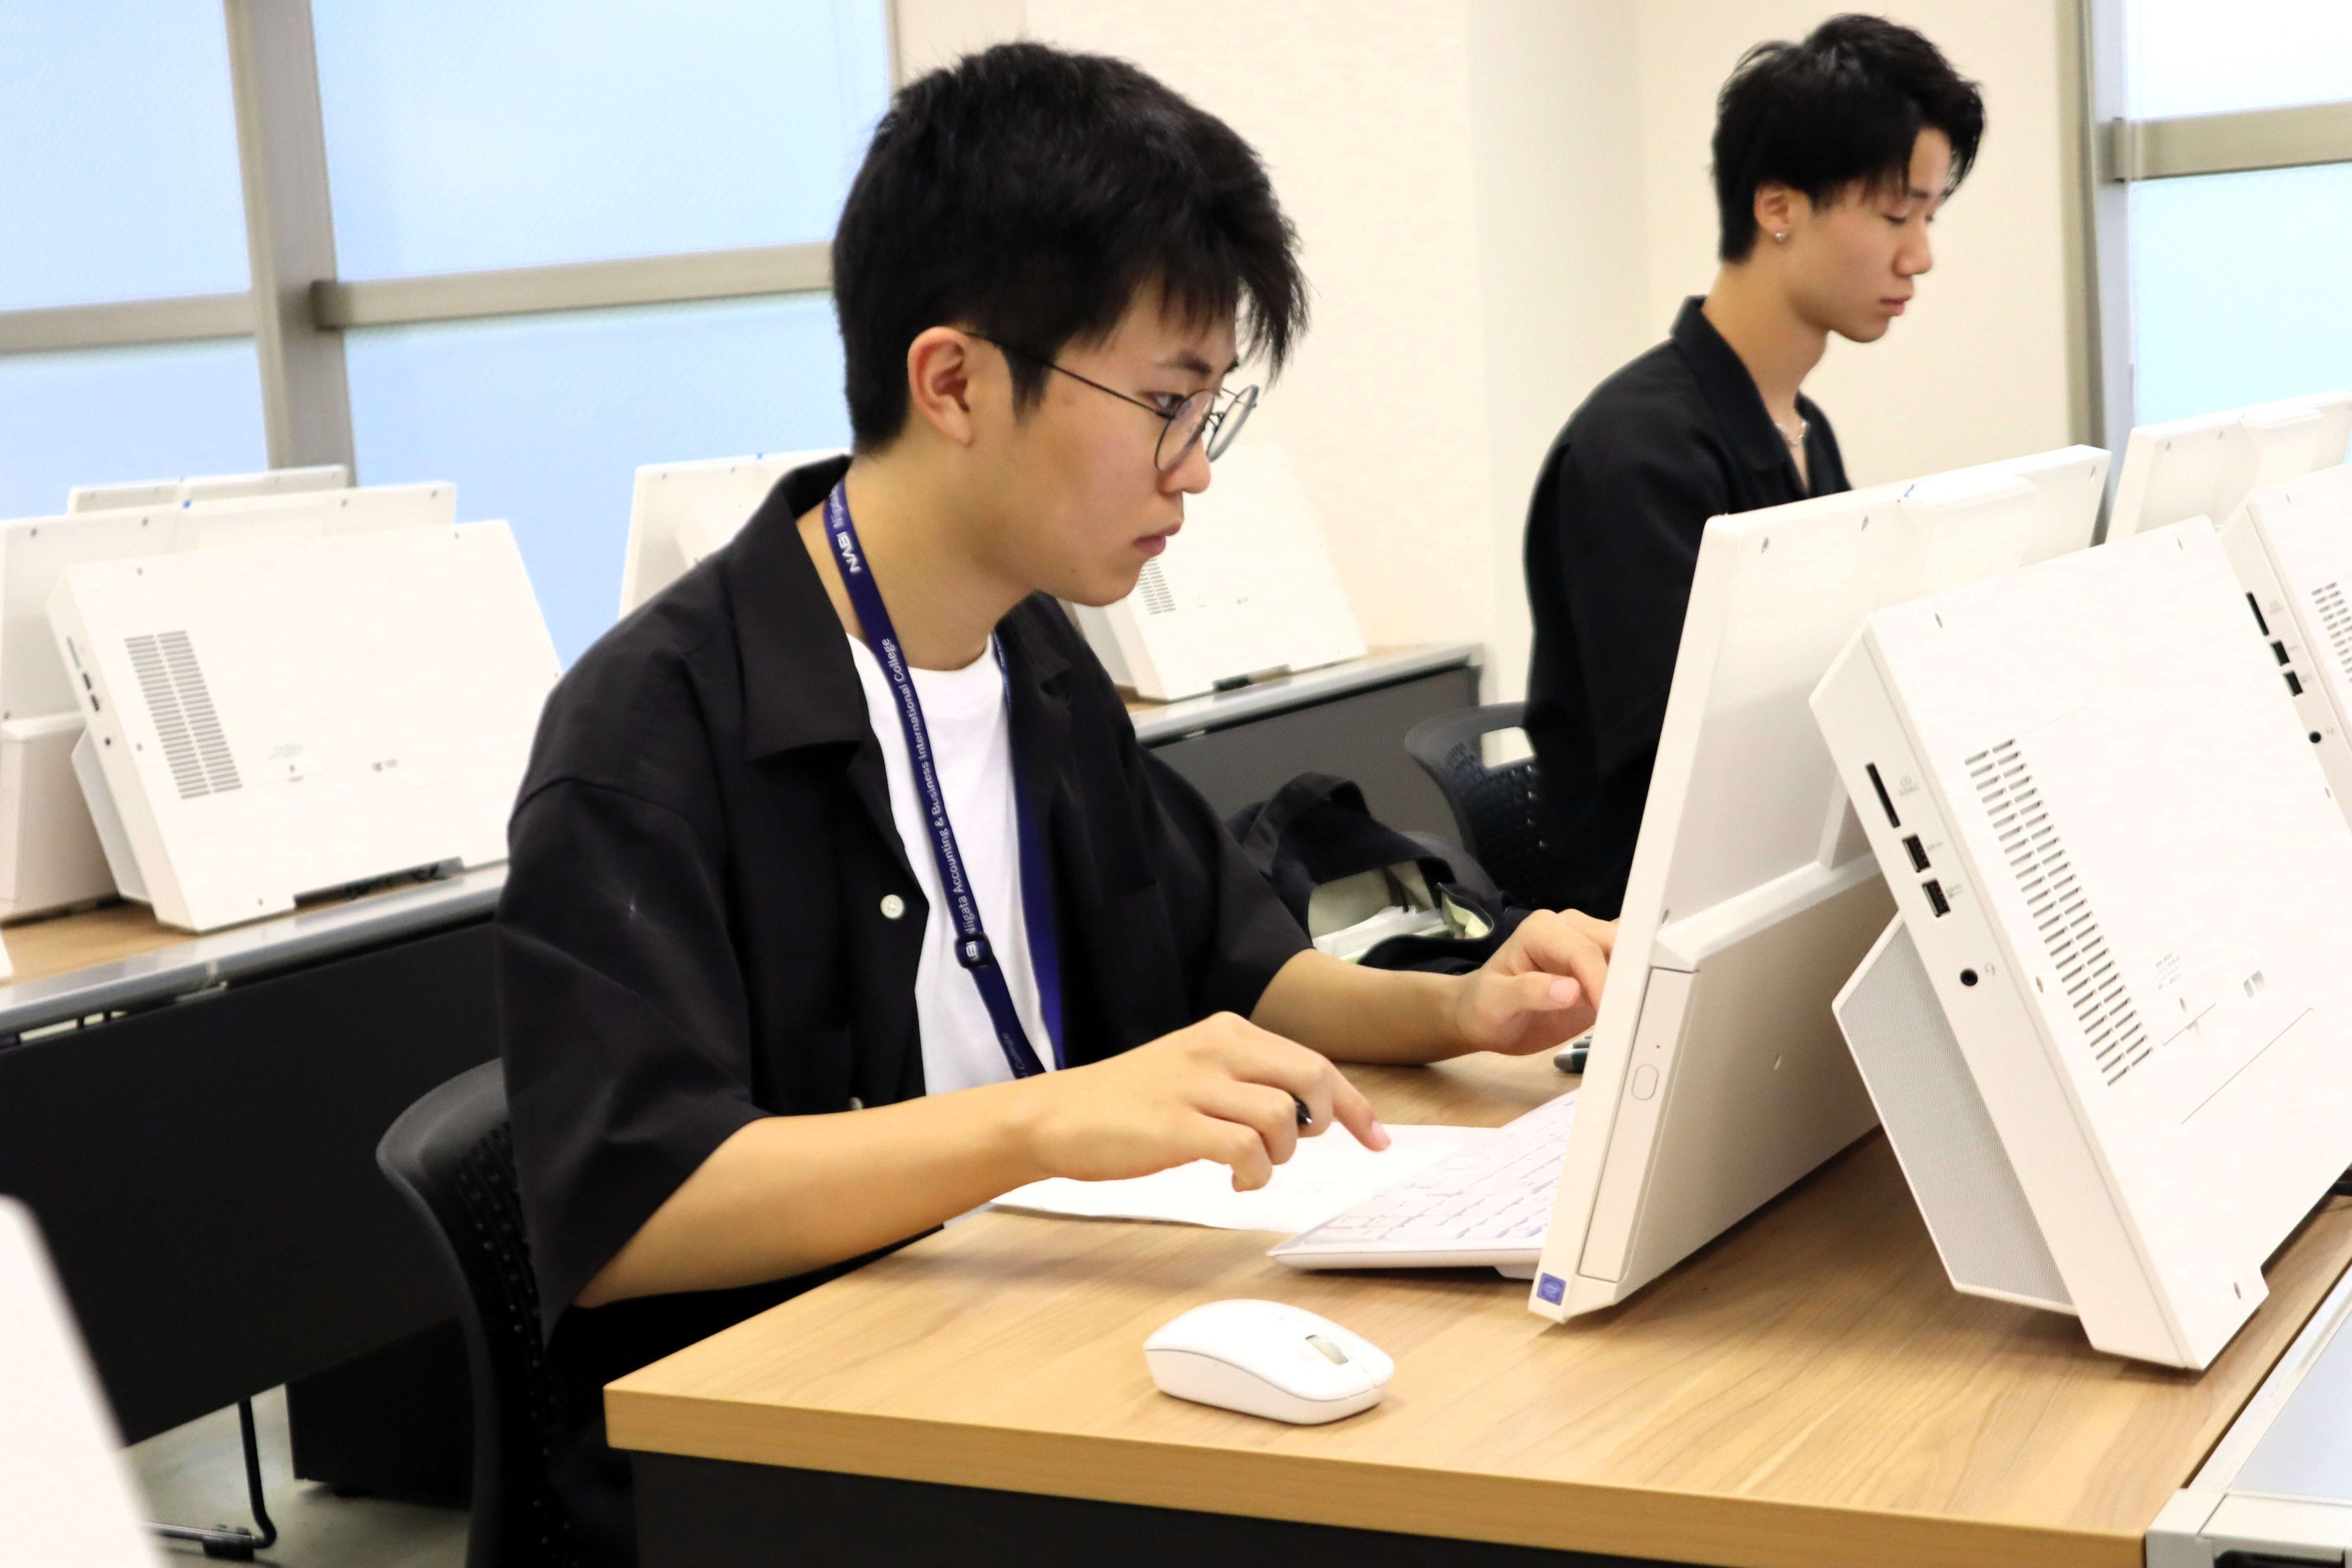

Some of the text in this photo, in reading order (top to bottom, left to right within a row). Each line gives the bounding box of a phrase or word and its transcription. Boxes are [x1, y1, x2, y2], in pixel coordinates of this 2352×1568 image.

[882, 638, 904, 681] College
[899, 684, 927, 760] International
[922, 761, 941, 815] Business
[934, 817, 944, 827] &
[938, 827, 964, 893] Accounting
[958, 895, 975, 934] Niigata
